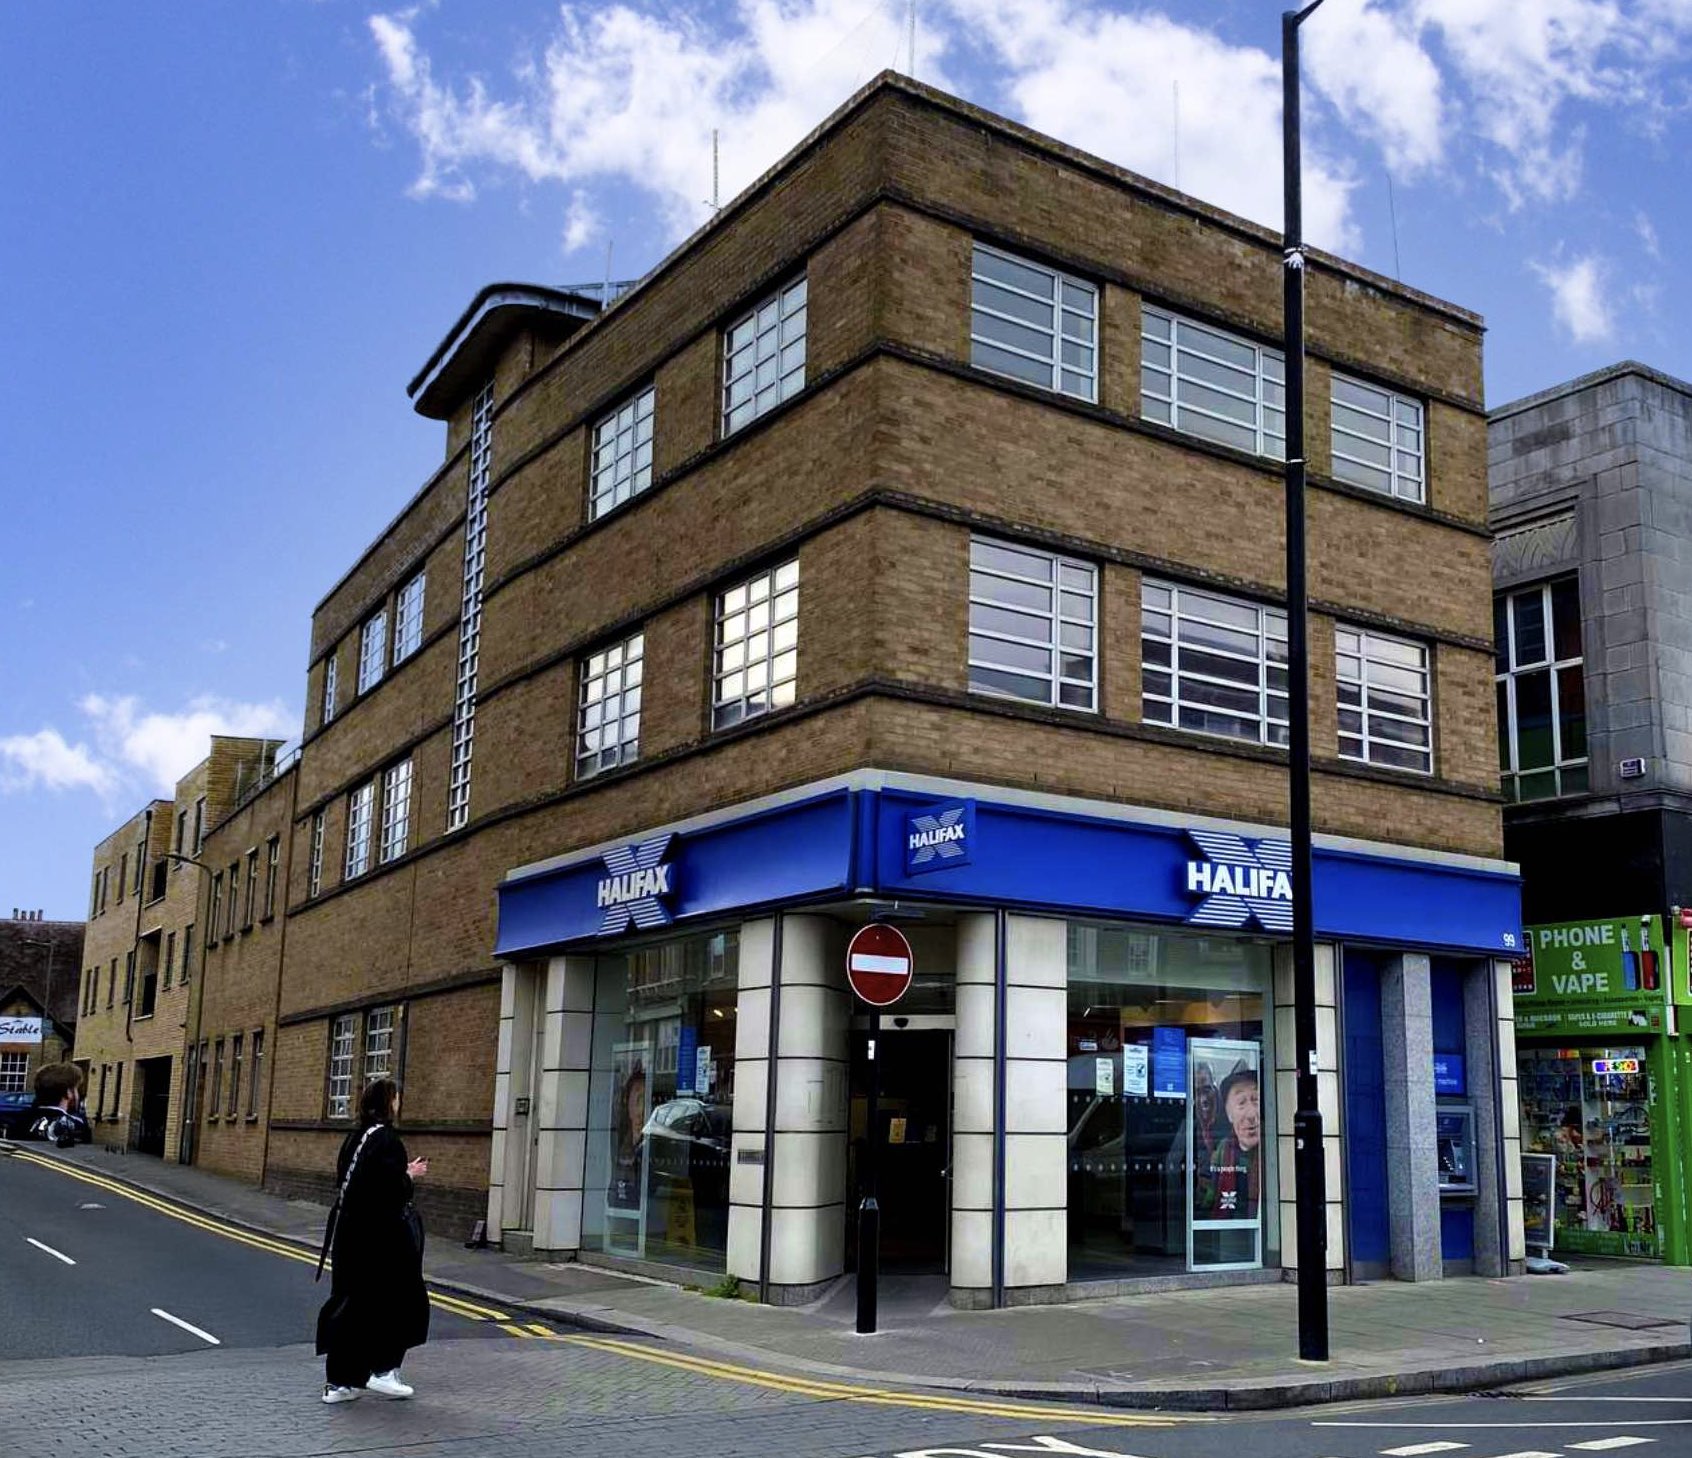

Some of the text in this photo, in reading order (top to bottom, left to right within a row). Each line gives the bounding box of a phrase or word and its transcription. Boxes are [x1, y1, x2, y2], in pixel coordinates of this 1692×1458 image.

[908, 823, 965, 851] HALIFAX
[597, 864, 669, 908] HALIFAX
[1187, 861, 1293, 900] HALIFA
[1503, 933, 1516, 948] 99
[1540, 925, 1615, 949] PHONE
[1571, 951, 1586, 971] &
[1552, 973, 1609, 994] VAPE
